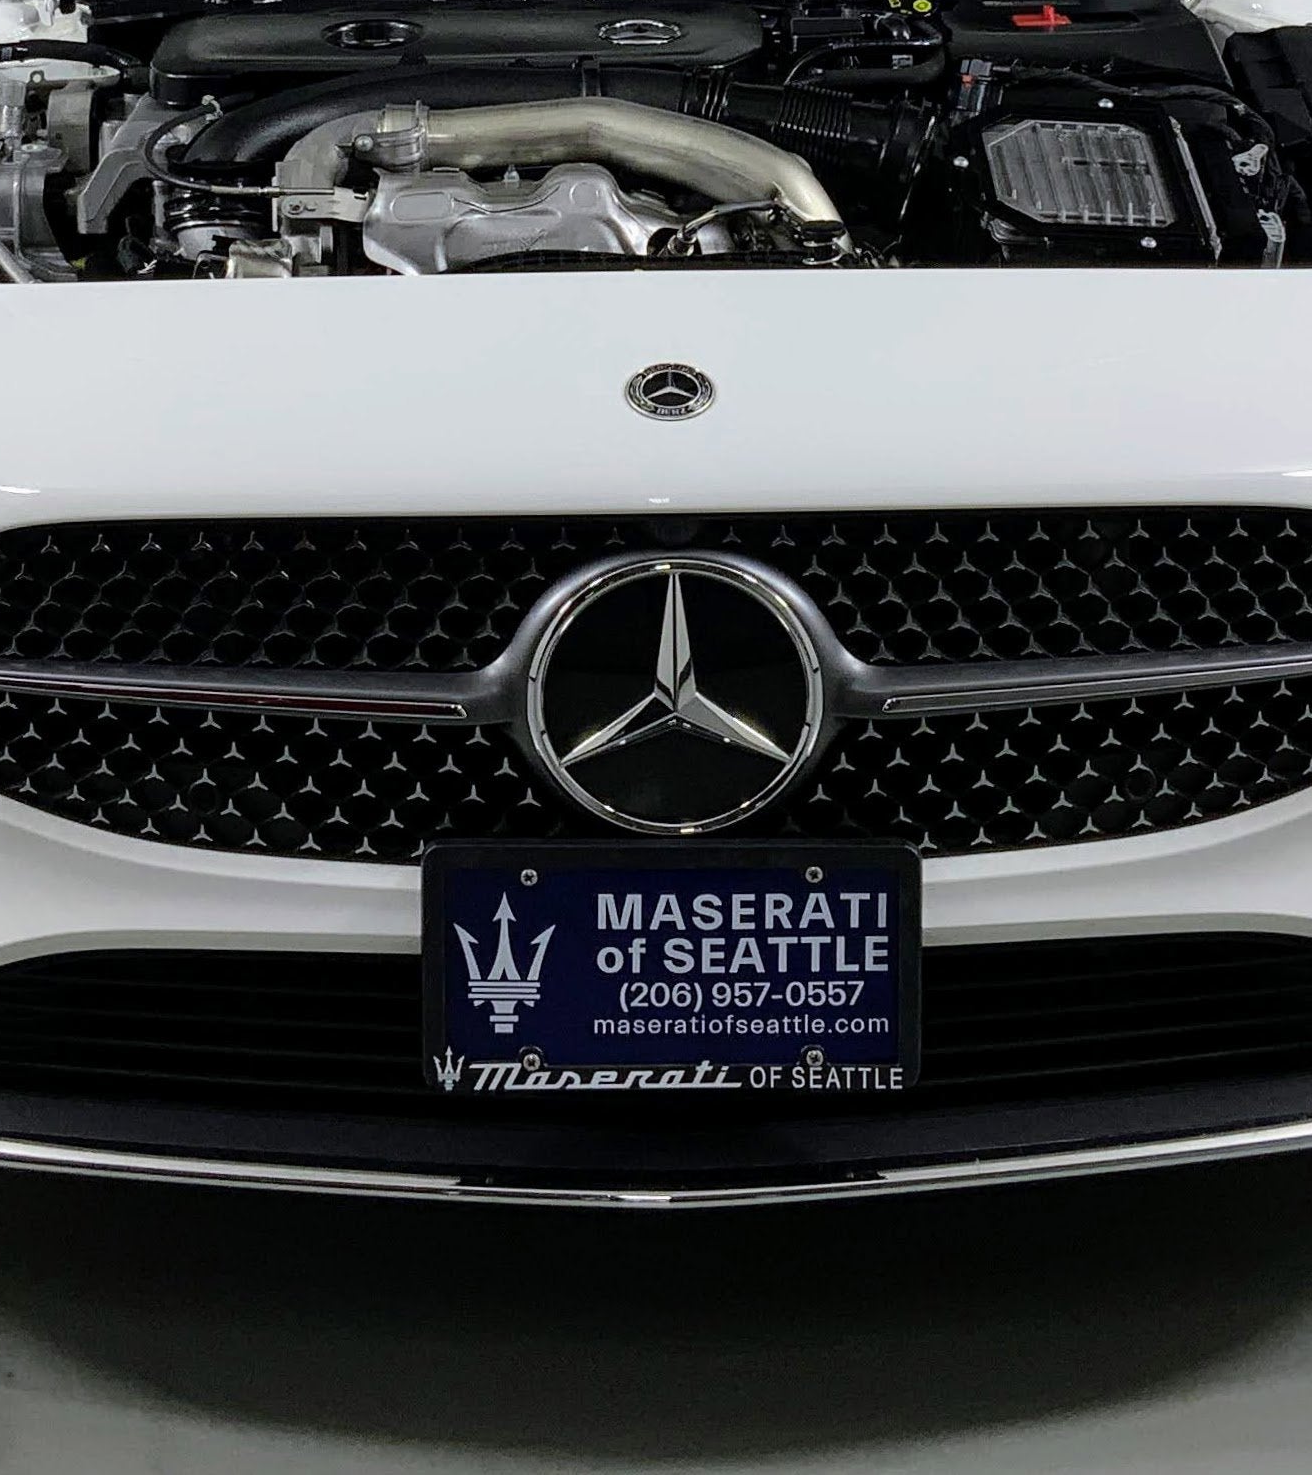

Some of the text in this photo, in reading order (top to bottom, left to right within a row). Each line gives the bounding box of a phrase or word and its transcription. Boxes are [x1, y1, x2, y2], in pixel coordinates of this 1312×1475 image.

[596, 892, 888, 931] MASERATI
[596, 935, 889, 974] of SEATTLE
[619, 980, 865, 1013] (206) 957-0557
[593, 1014, 890, 1035] maseratiofseattle.com
[469, 1060, 904, 1091] Maserati OF SEATTLE
